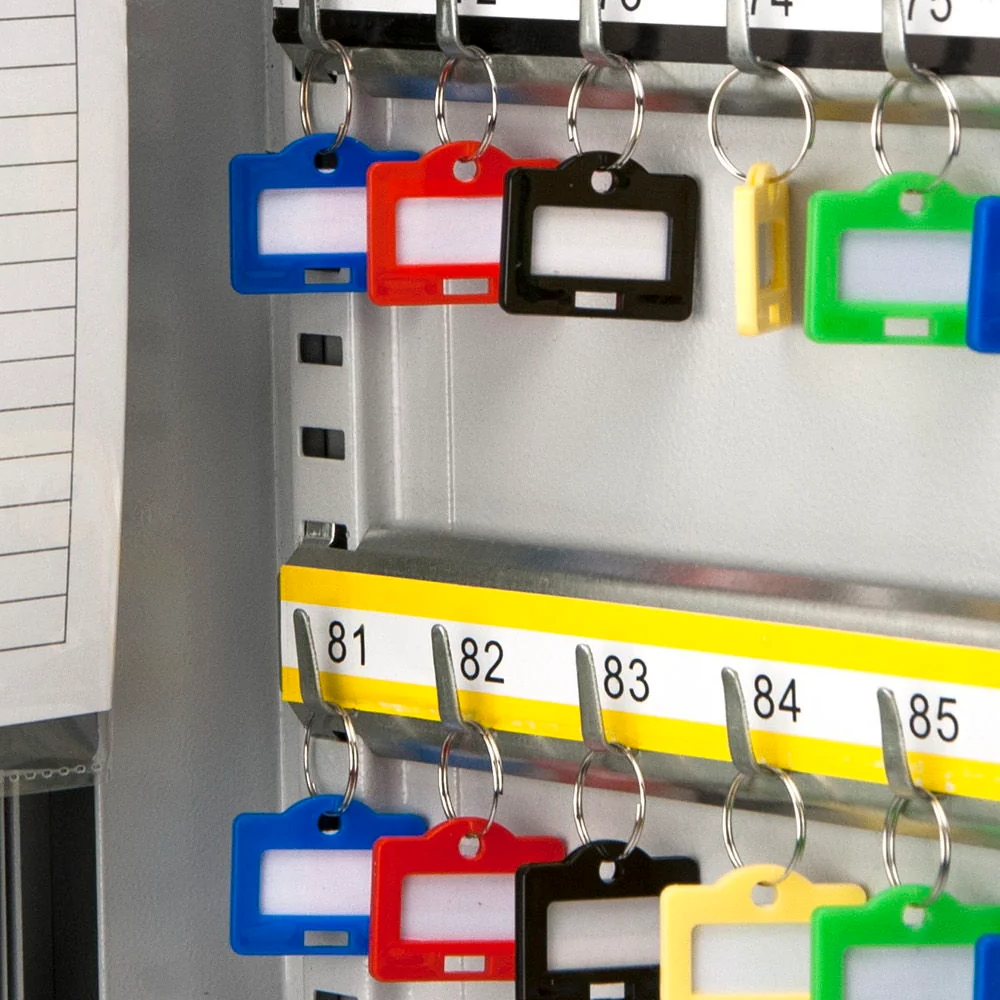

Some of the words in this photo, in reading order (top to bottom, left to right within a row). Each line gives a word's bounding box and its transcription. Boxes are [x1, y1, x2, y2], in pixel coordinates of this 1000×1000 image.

[328, 620, 367, 667] 81
[460, 636, 505, 685] 82
[603, 654, 650, 703] 83
[752, 673, 801, 723] 84
[909, 692, 960, 743] 85
